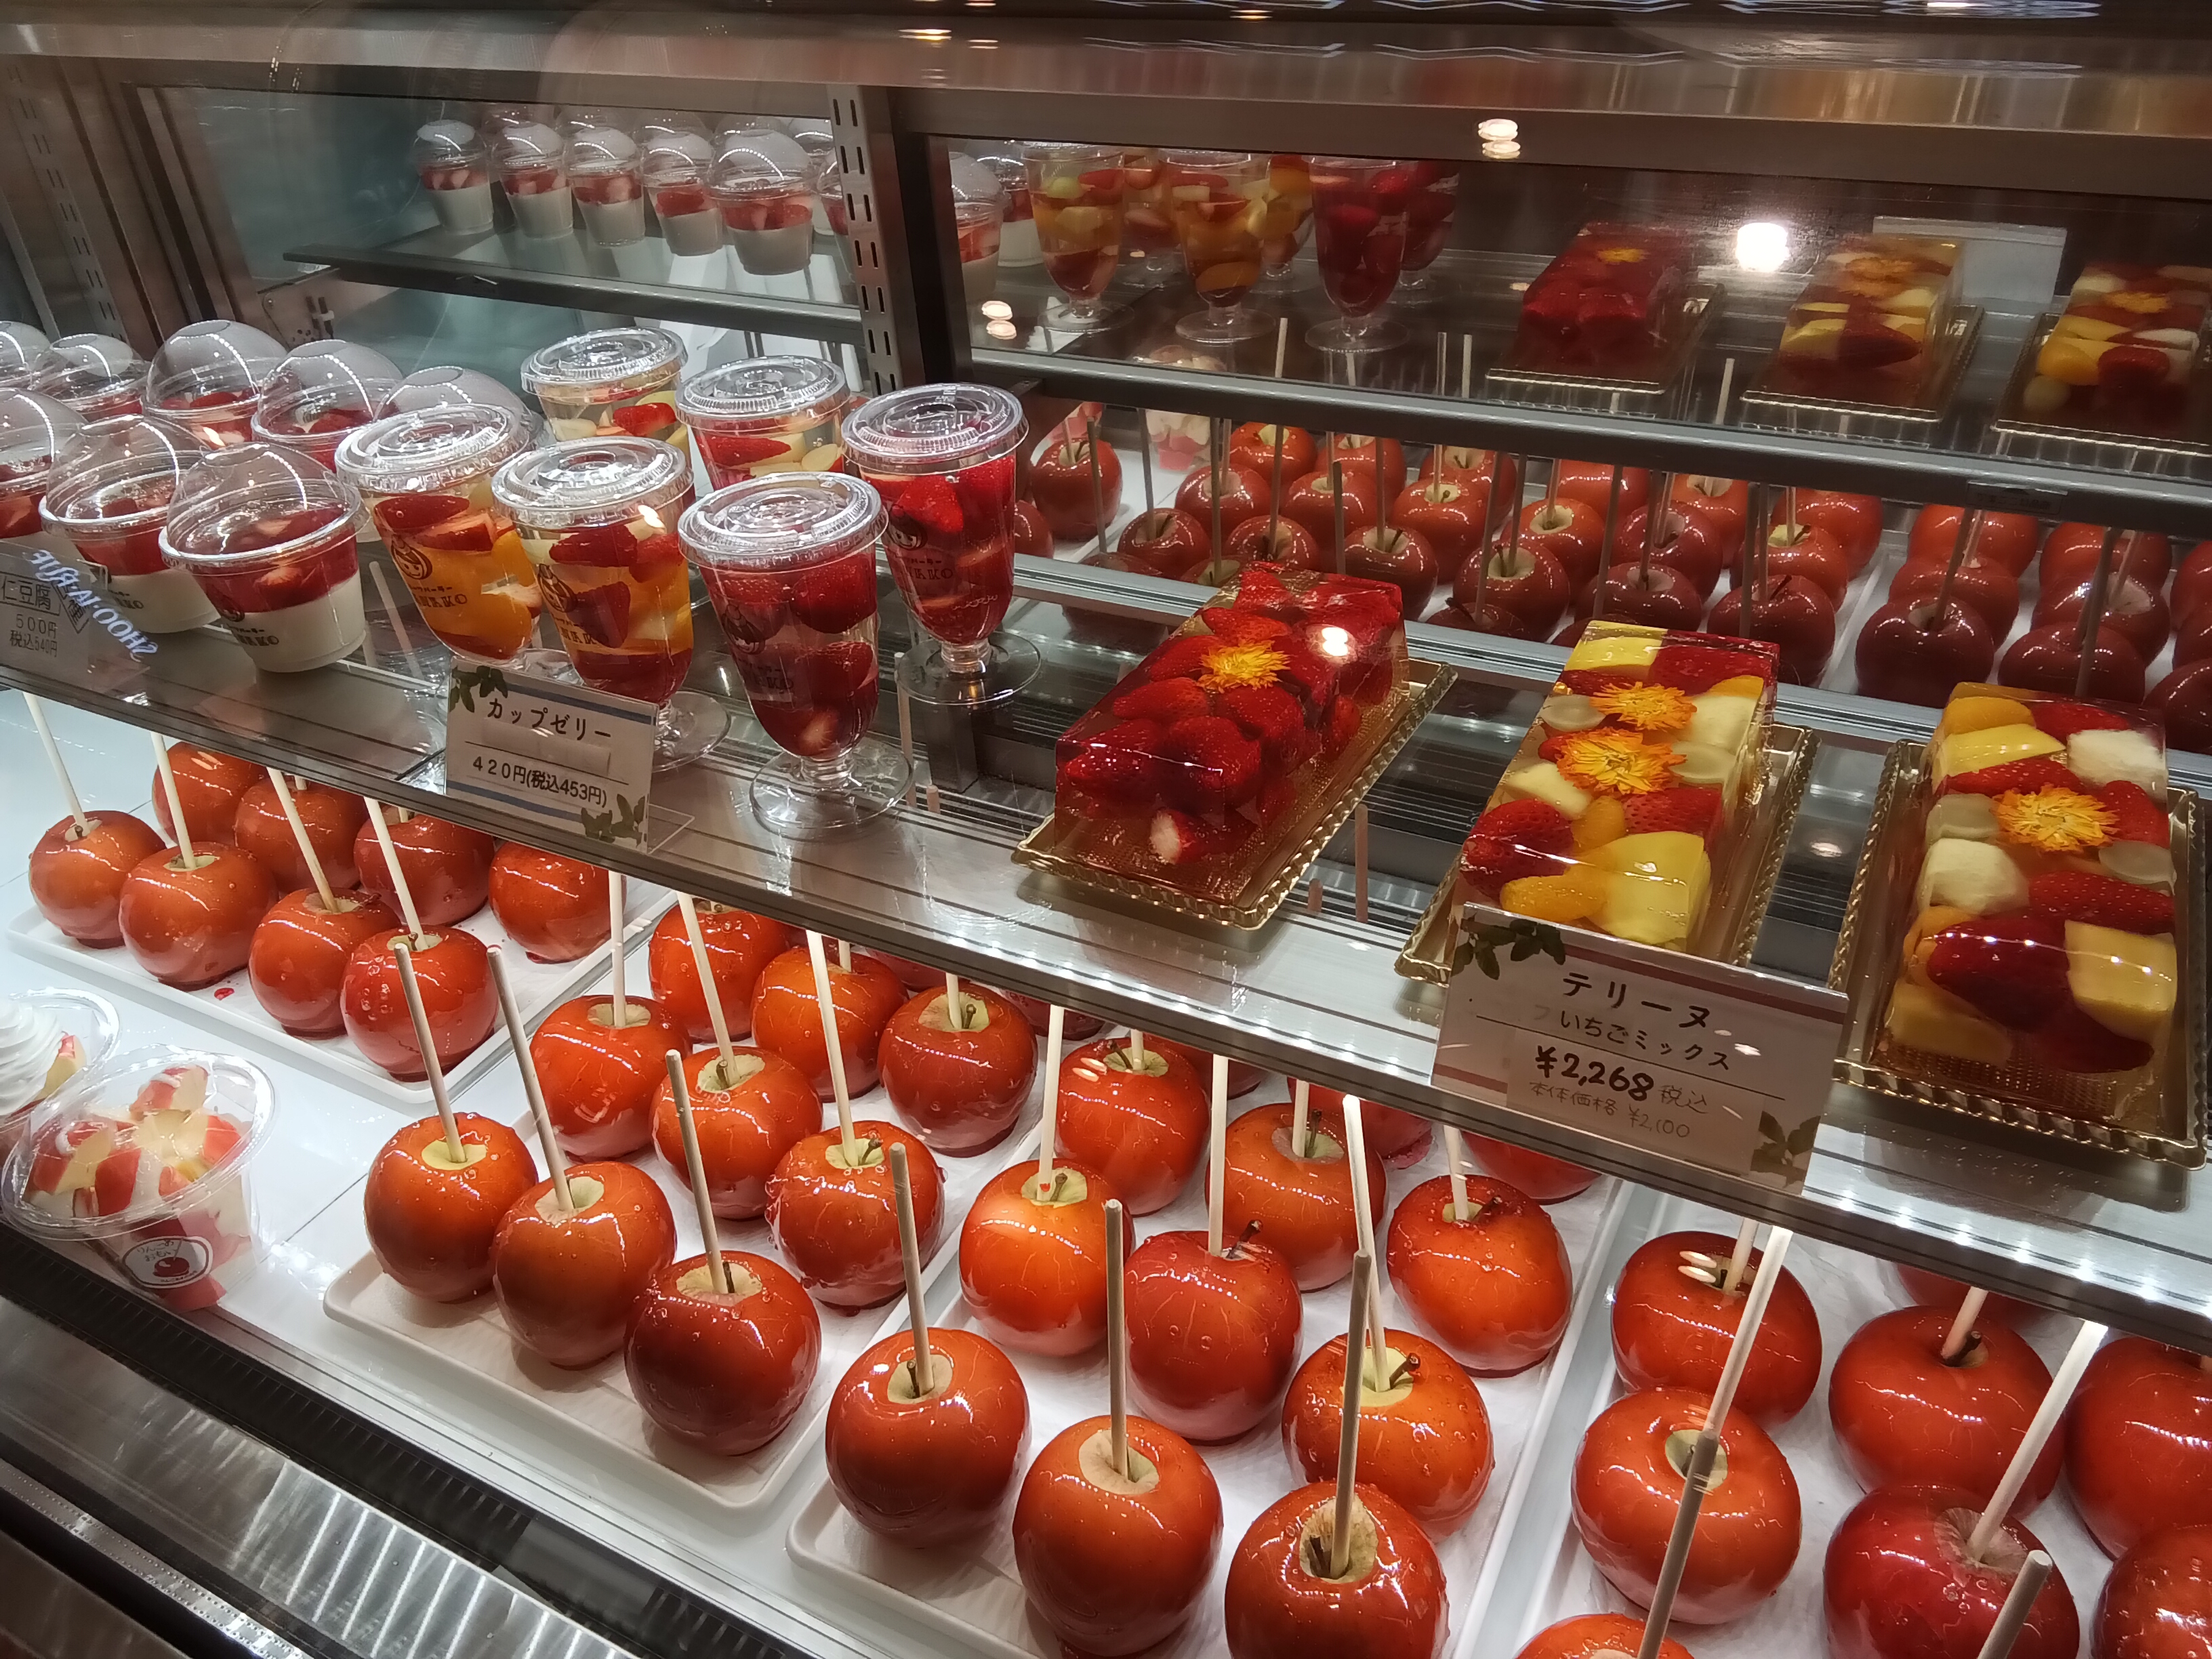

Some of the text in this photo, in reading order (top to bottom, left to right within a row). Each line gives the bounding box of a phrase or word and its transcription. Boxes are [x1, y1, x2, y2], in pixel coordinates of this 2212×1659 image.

[16, 613, 57, 639] 500円
[487, 697, 611, 741] カップゼリー
[1563, 972, 1711, 1029] テリーヌ
[1560, 1009, 1729, 1071] いちごミックス
[1535, 1044, 1654, 1101] ¥2,268
[1529, 1081, 1691, 1139] 本体価格 ¥2,100
